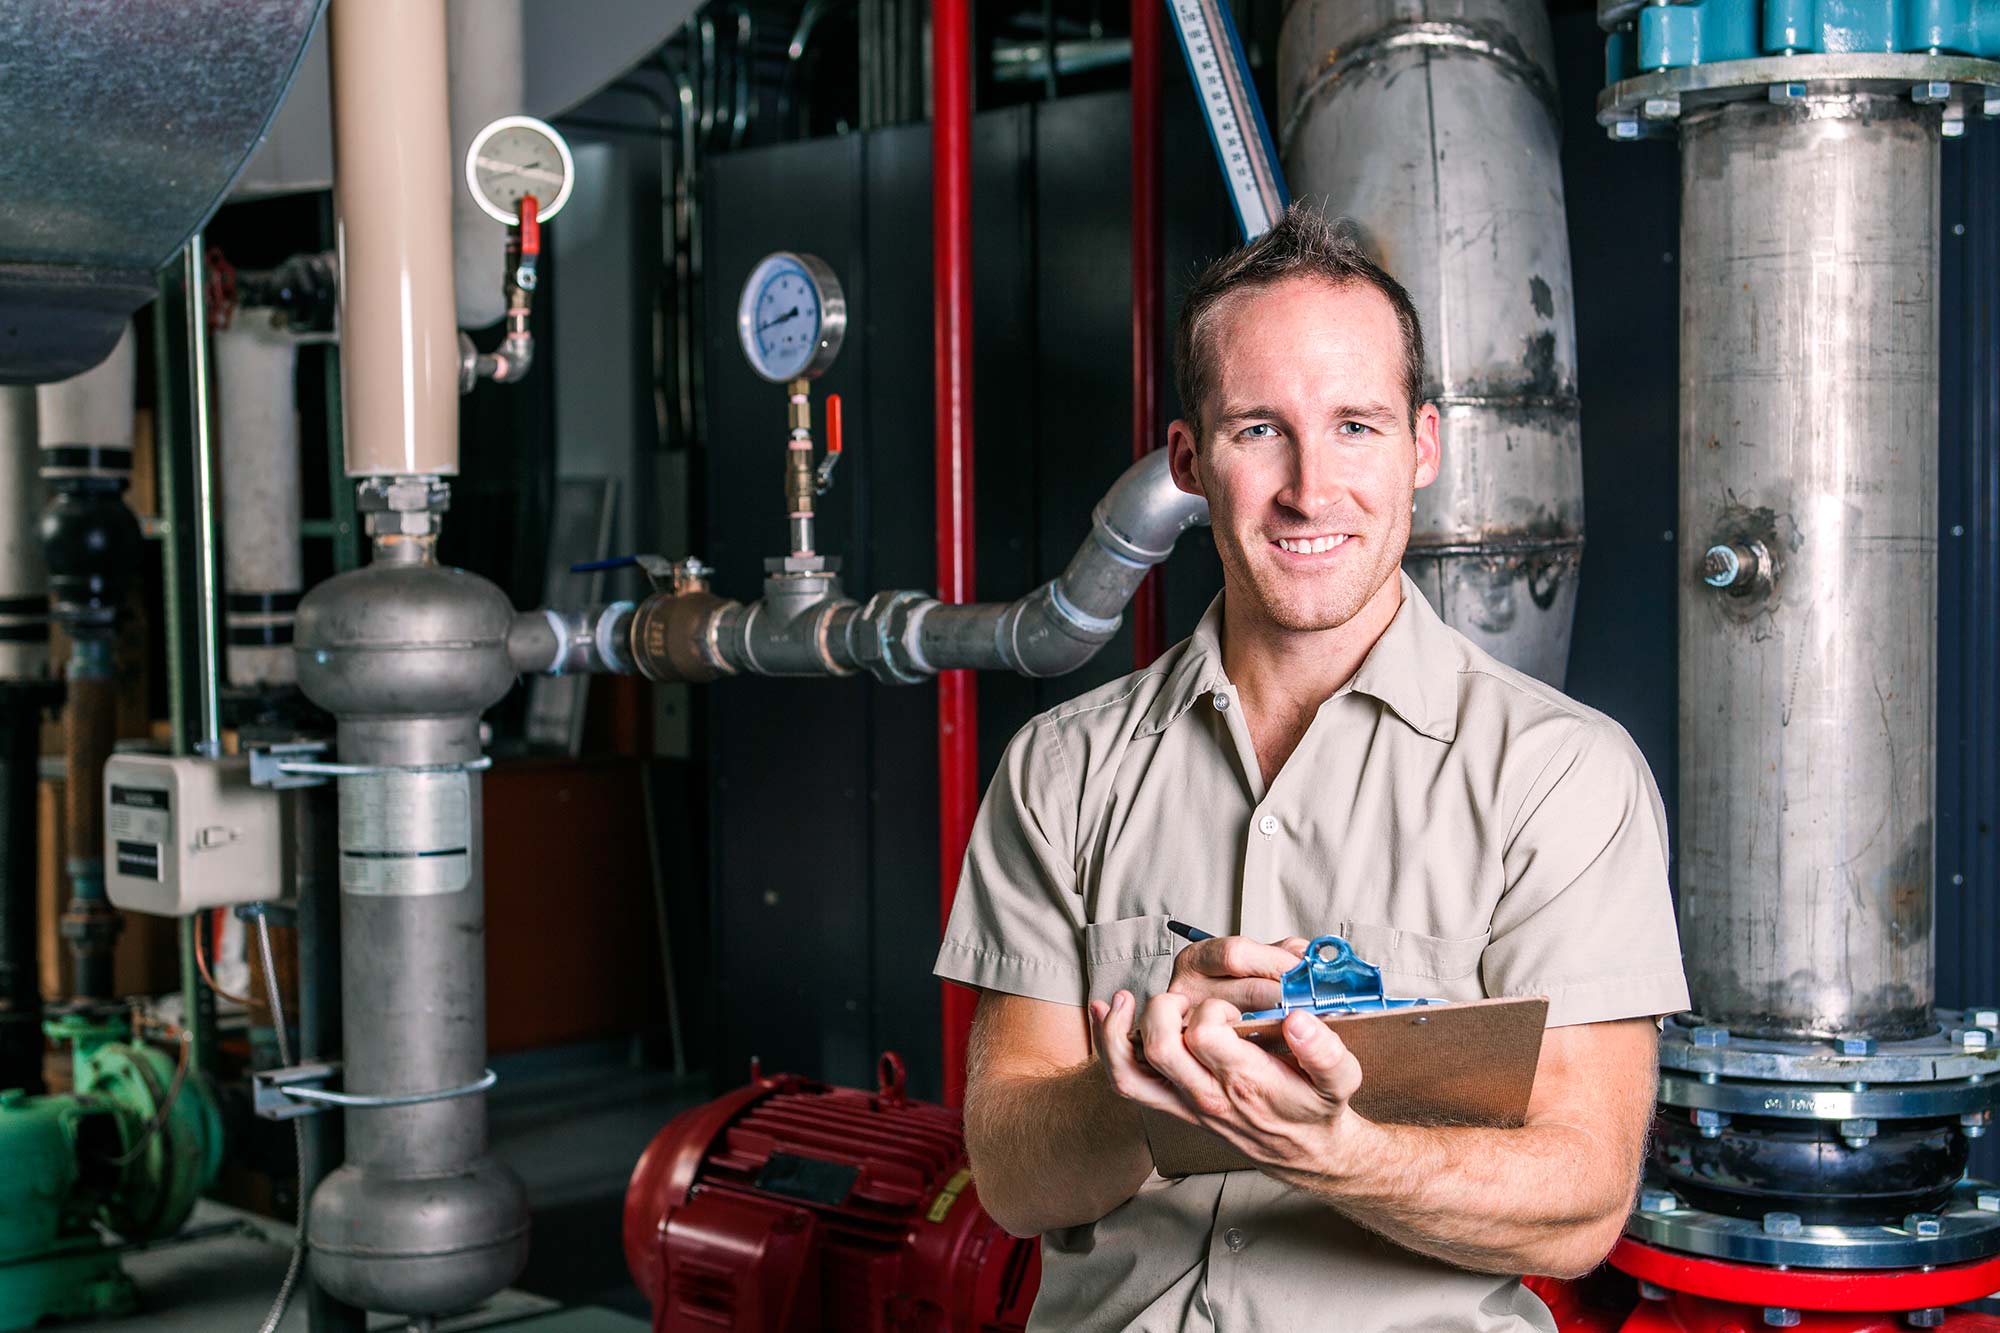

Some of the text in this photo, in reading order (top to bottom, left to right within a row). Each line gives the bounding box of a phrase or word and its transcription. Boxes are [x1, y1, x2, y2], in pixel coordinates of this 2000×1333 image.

[1188, 30, 1201, 39] 100
[1207, 76, 1216, 85] 70
[1217, 106, 1226, 116] 50
[1222, 122, 1231, 131] 40
[1227, 137, 1236, 147] 30
[1232, 152, 1241, 162] 20
[1237, 167, 1246, 176] 10
